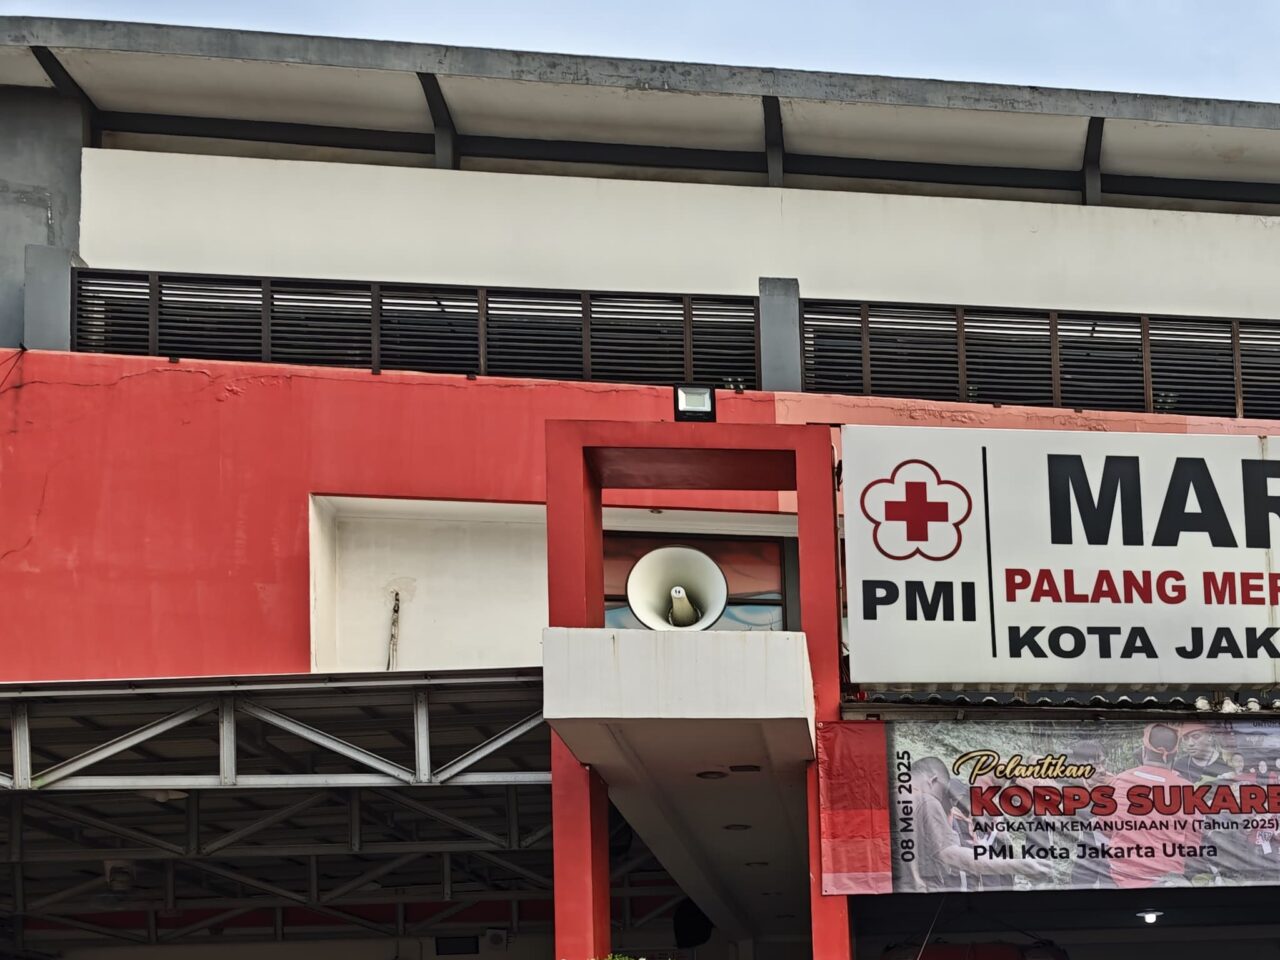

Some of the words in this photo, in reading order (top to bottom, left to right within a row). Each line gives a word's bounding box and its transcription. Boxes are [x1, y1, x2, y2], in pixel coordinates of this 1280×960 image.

[861, 579, 977, 622] PMI
[1005, 568, 1187, 605] PALANG
[1008, 625, 1159, 660] KOTA
[896, 750, 913, 794] 2025
[952, 750, 1096, 785] Pelantikan
[896, 800, 914, 833] Mei
[970, 785, 1117, 818] KORPS
[973, 820, 1056, 834] ANGKATAN
[1060, 819, 1170, 833] KEMANUSIAAN
[1174, 819, 1189, 831] IV
[1191, 818, 1239, 834] (Tahun
[1243, 817, 1280, 833] 2025)
[900, 839, 915, 863] 08
[973, 845, 1015, 861] PMI
[1021, 843, 1070, 860] Kota
[1076, 843, 1157, 860] Jakarta
[1162, 842, 1218, 859] Utara
